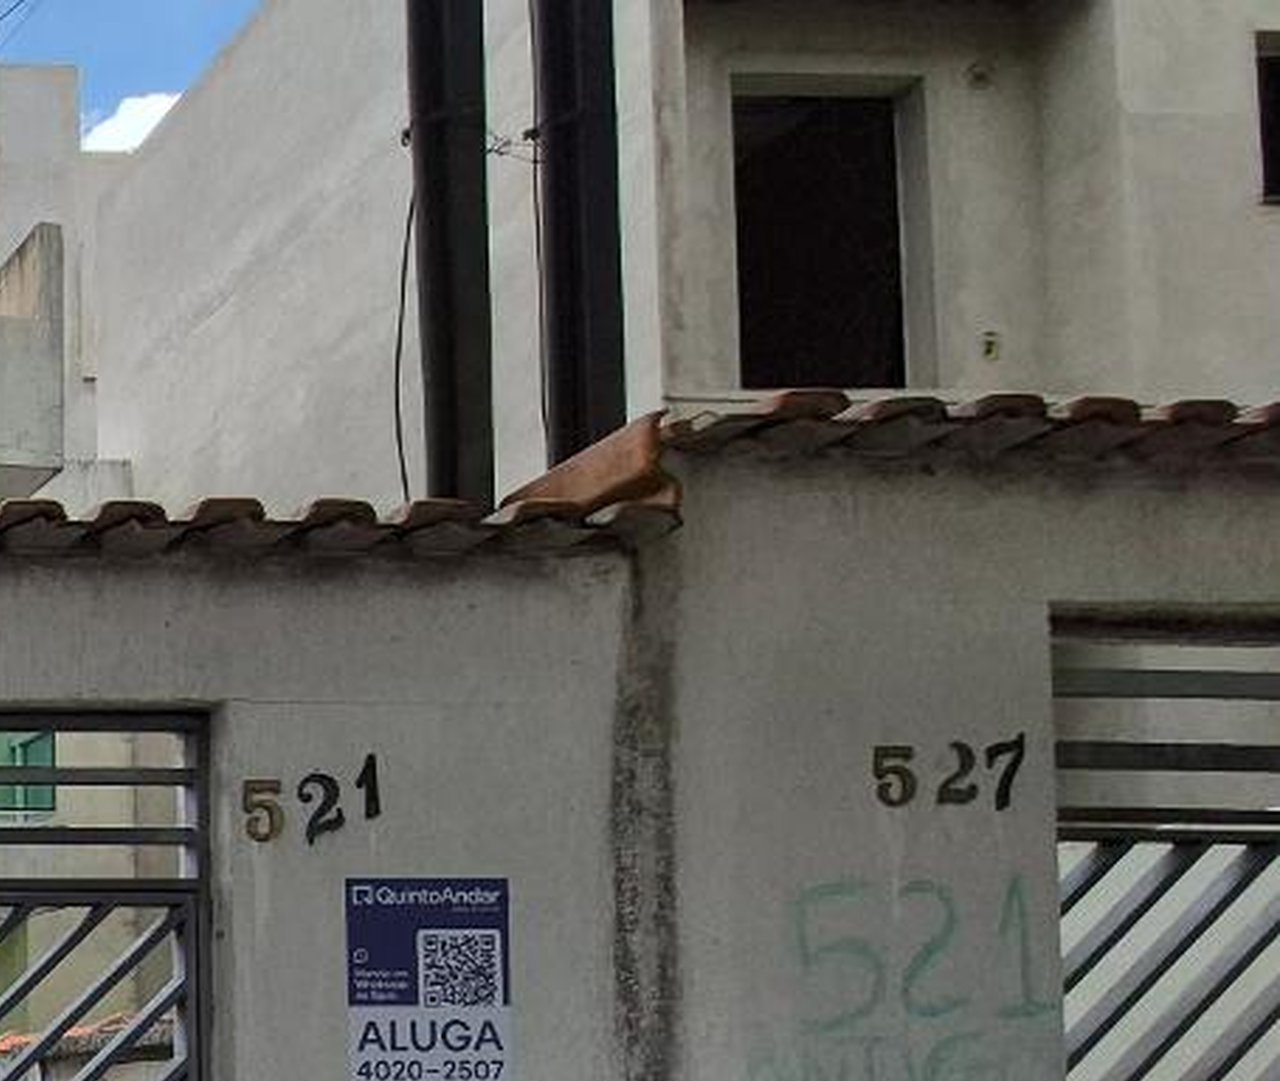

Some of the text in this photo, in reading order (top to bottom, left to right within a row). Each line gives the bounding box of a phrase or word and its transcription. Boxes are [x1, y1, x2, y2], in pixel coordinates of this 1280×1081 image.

[242, 753, 381, 845] 521
[872, 733, 1026, 811] 527
[376, 886, 501, 905] QuintoAndar
[792, 873, 1061, 1034] 521
[357, 1019, 504, 1052] ALUGA
[356, 1060, 504, 1081] 4020-2507
